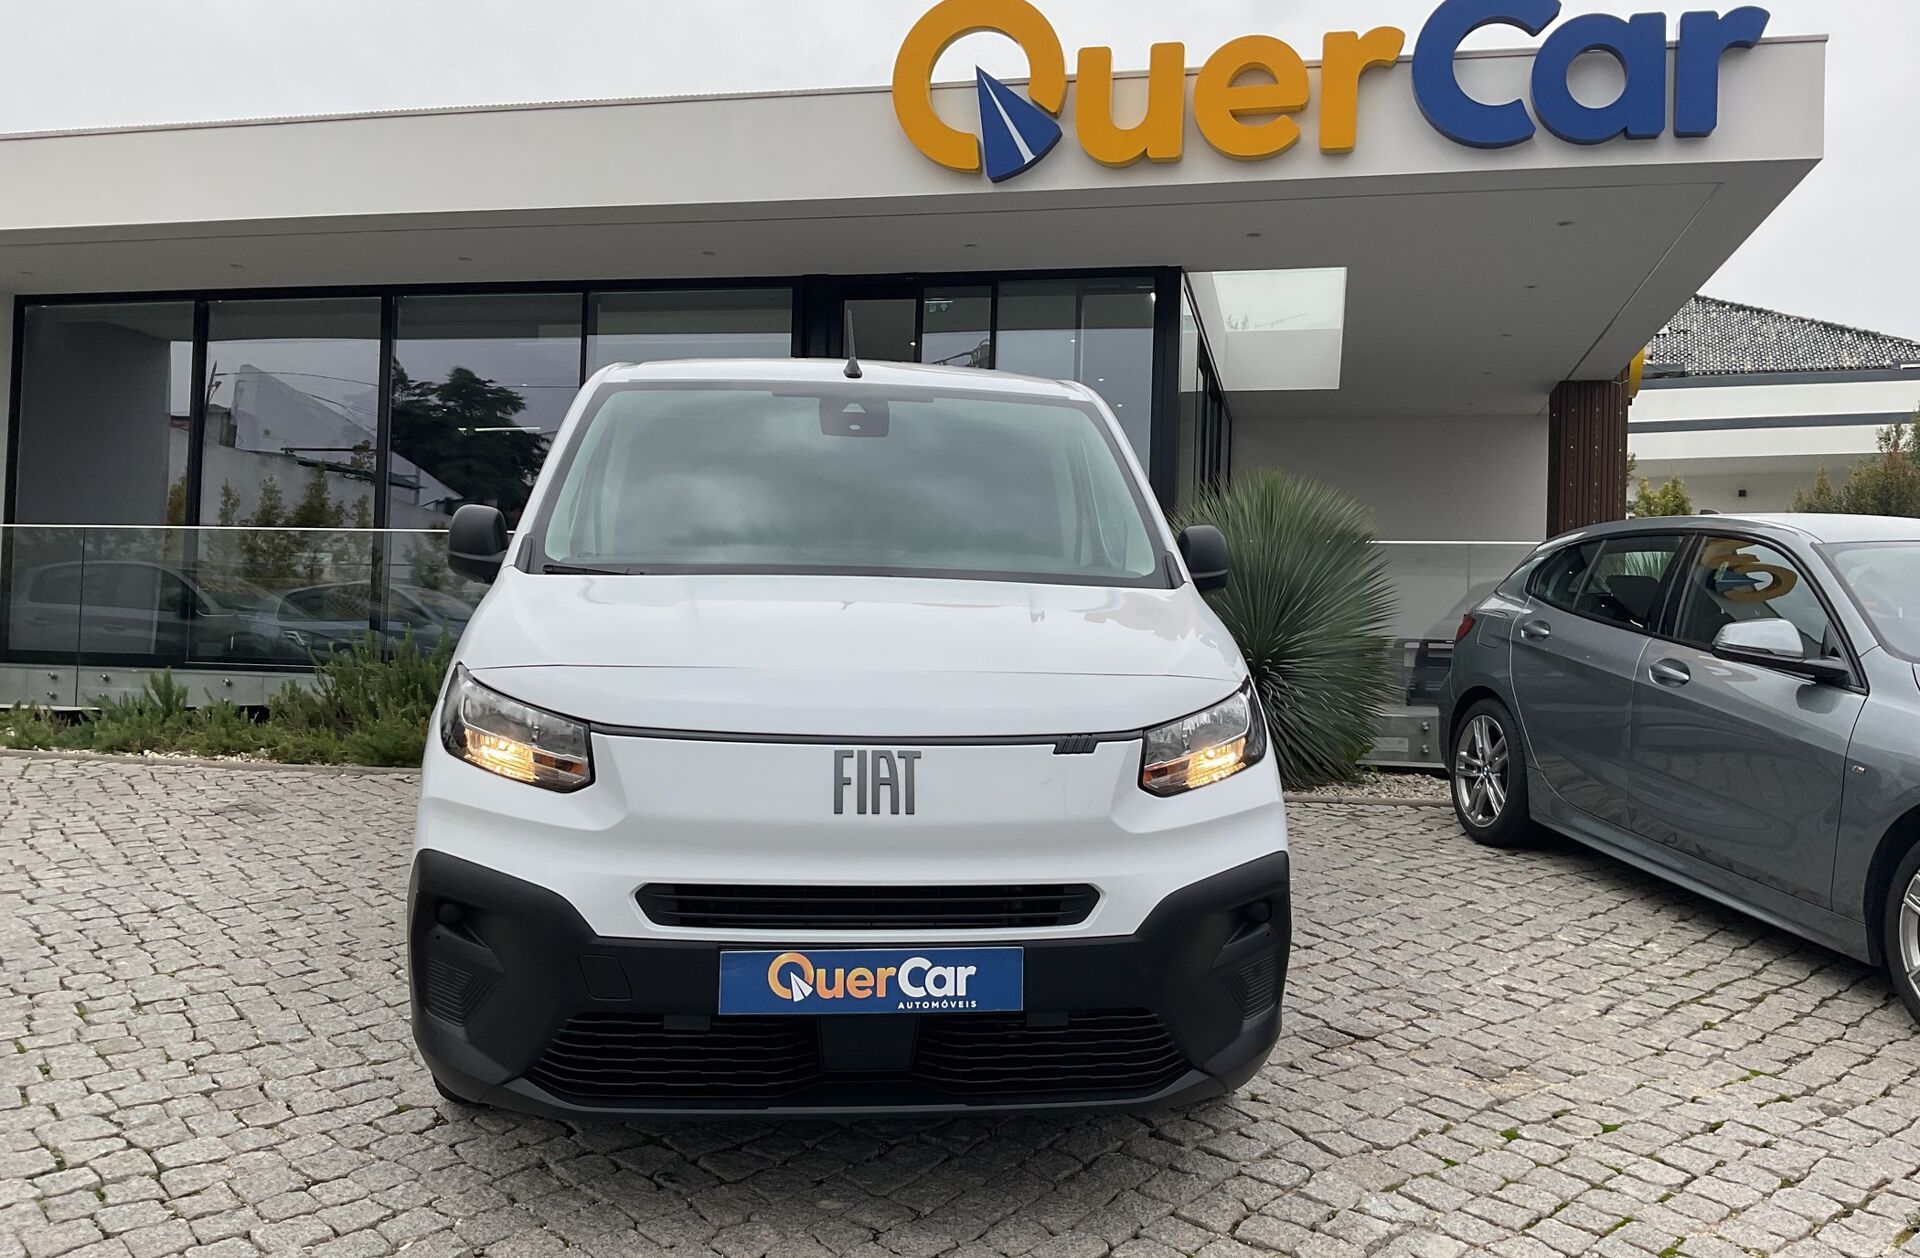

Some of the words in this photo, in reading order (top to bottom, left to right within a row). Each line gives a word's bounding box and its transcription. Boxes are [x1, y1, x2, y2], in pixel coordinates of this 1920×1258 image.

[892, 0, 1771, 183] QuerCar
[833, 749, 922, 815] FIAT
[767, 952, 977, 1002] QuerCar
[897, 999, 977, 1009] AUTOMÓVEIS
